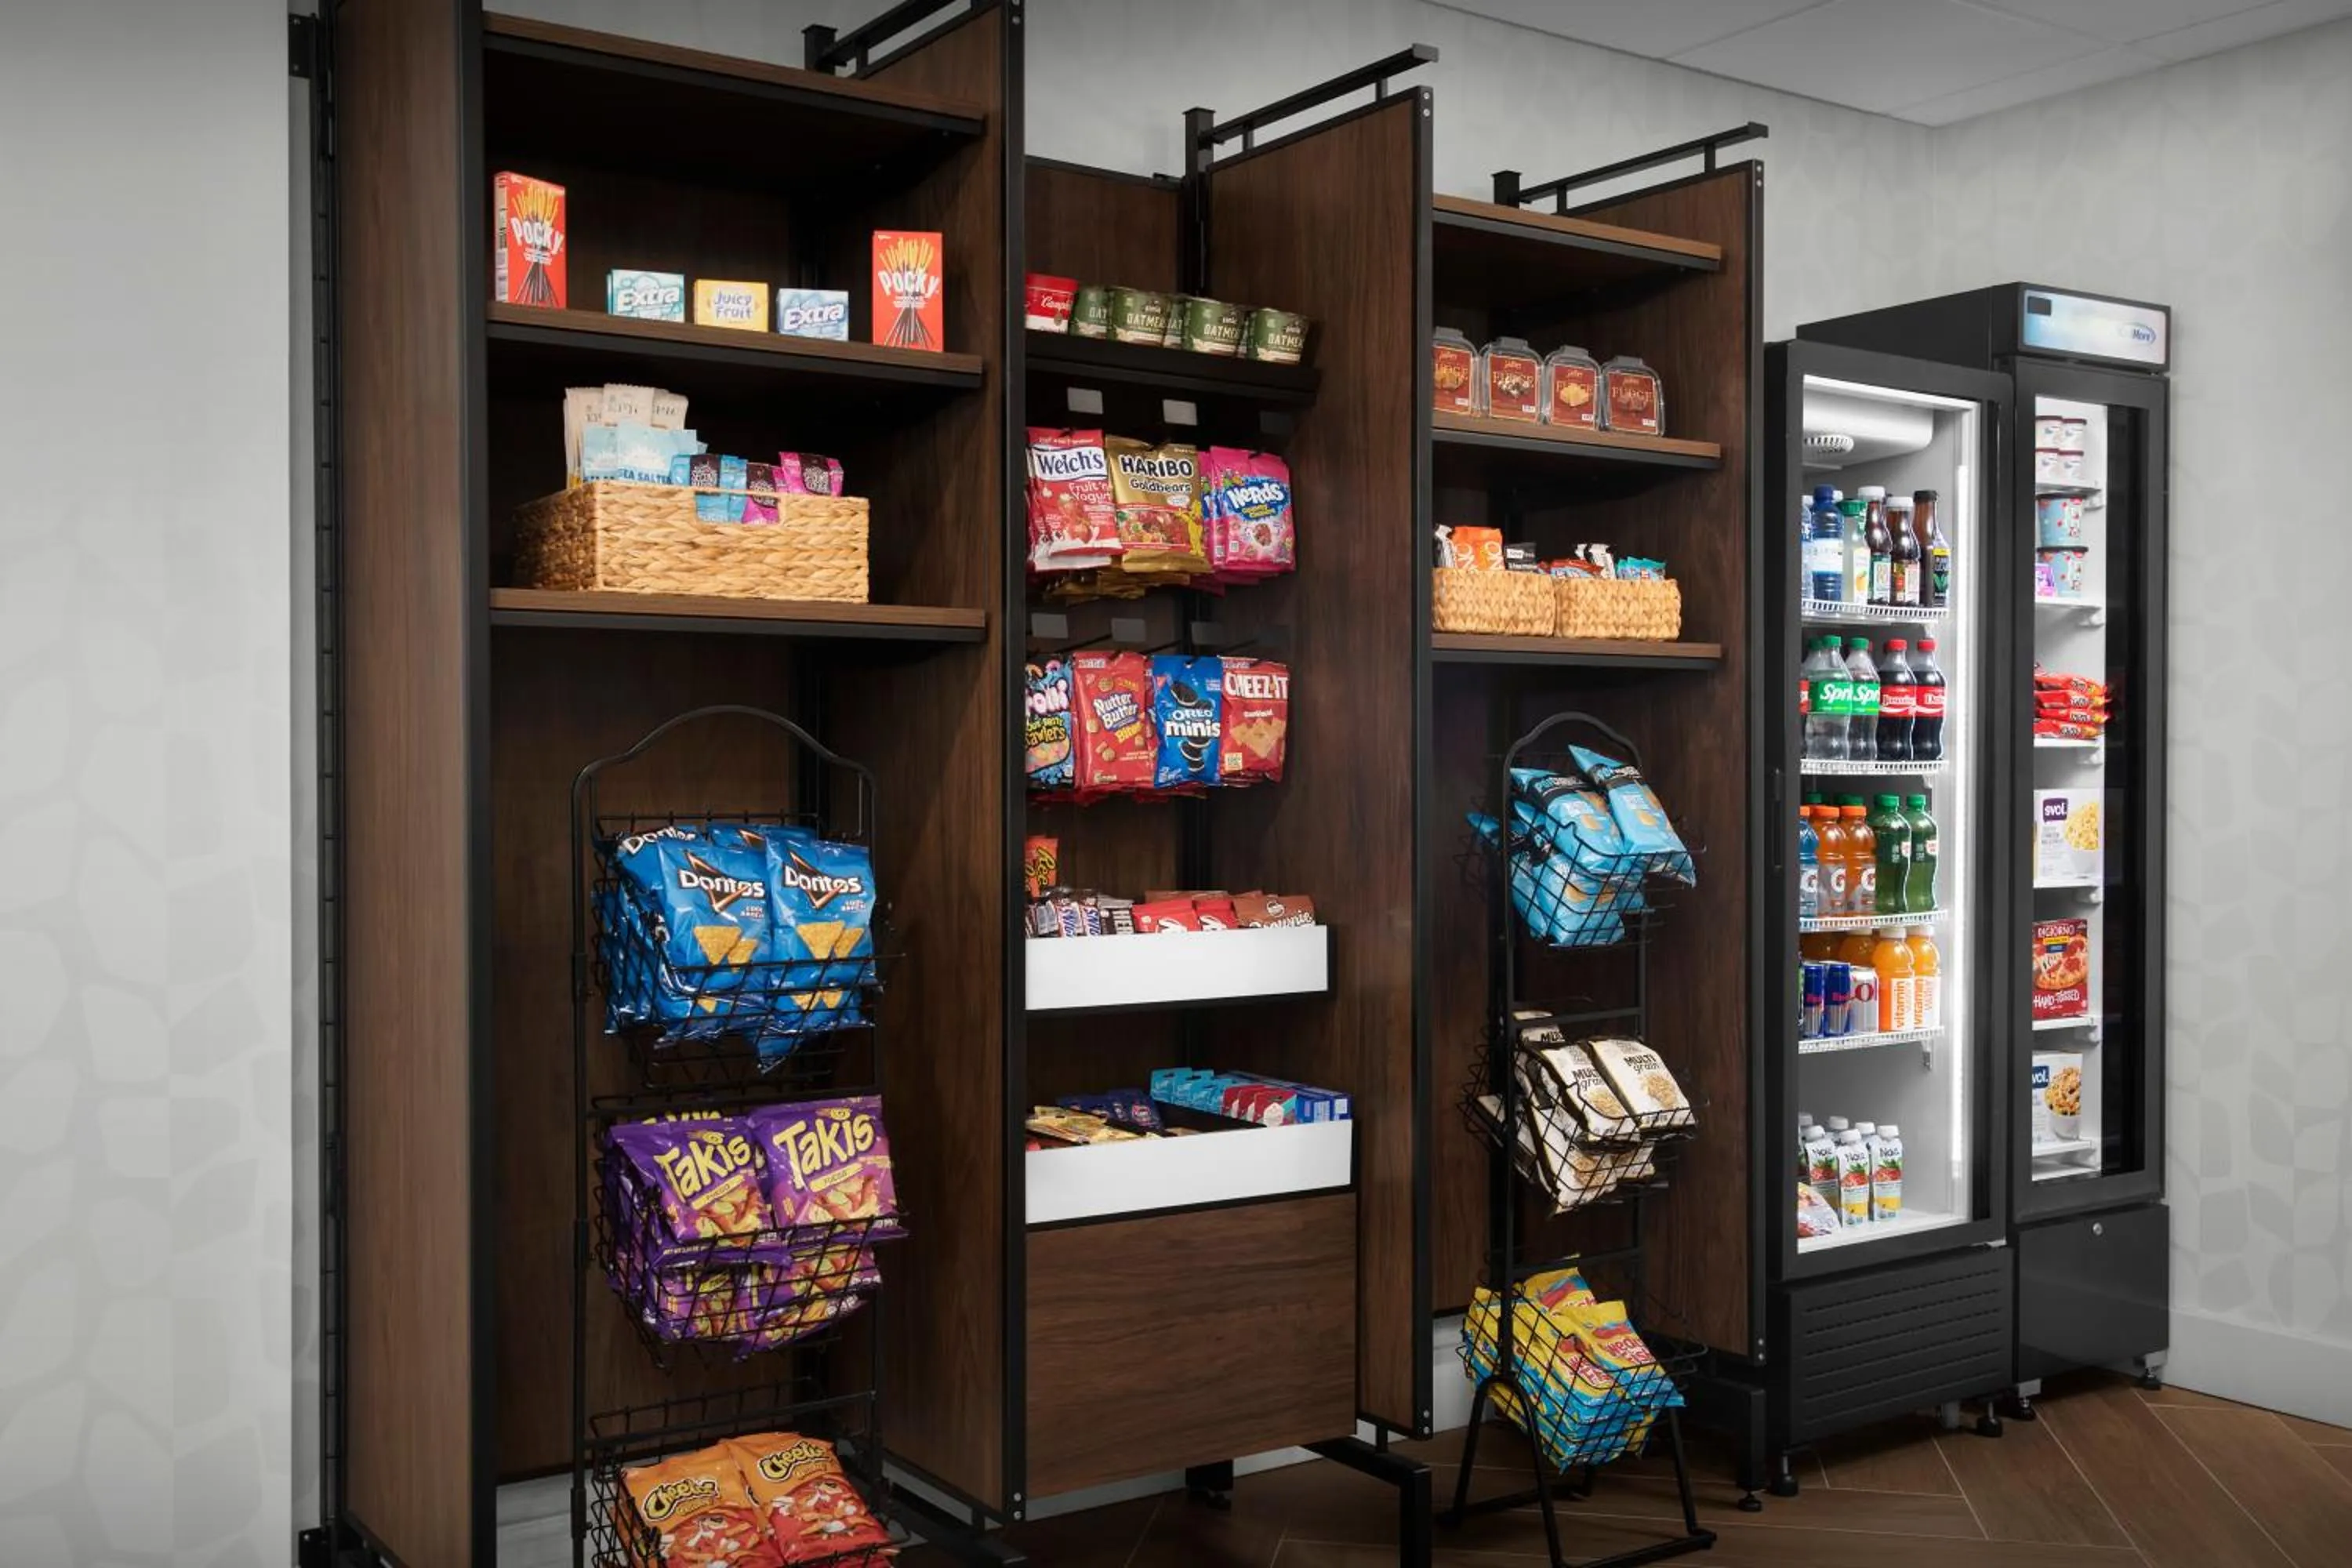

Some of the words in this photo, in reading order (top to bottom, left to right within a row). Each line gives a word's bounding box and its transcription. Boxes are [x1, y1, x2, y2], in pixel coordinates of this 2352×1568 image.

[1036, 450, 1104, 475] Welch's
[1120, 456, 1192, 477] HARIBO
[1069, 481, 1097, 492] Fruit
[1130, 478, 1191, 492] Goldbears
[1093, 694, 1131, 715] Nutter
[1172, 710, 1213, 720] OREO
[1102, 704, 1138, 729] Butter
[1165, 719, 1221, 738] minis
[679, 869, 766, 898] Doritos
[784, 865, 862, 895] Doritos
[1624, 1054, 1657, 1067] MULTI
[772, 1113, 875, 1190] Takis
[652, 1134, 751, 1203] Takis
